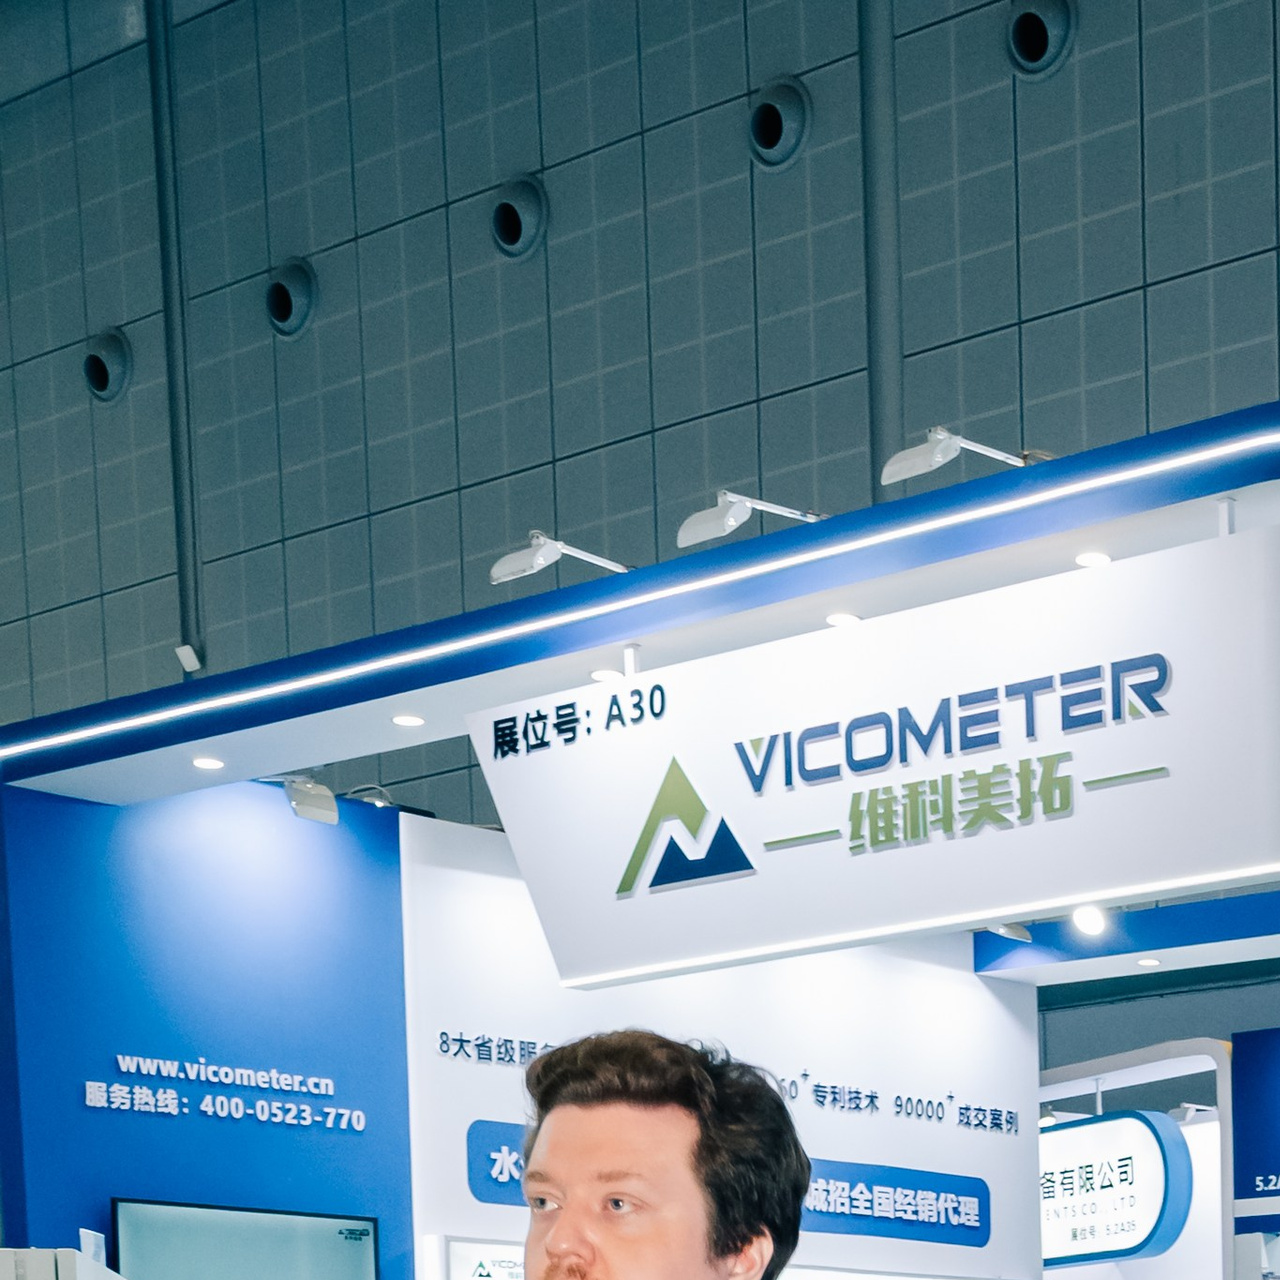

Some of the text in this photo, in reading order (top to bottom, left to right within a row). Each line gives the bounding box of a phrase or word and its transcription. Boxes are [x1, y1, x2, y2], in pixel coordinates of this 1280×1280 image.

[604, 684, 667, 731] A30
[734, 653, 1170, 794] VICOMETER
[848, 752, 1073, 854] 维科美拓
[116, 1054, 335, 1096] www.vicometer.cn
[199, 1094, 367, 1132] 400-0523-770
[489, 1145, 525, 1183] 水
[1040, 1155, 1135, 1200] 备有限公司
